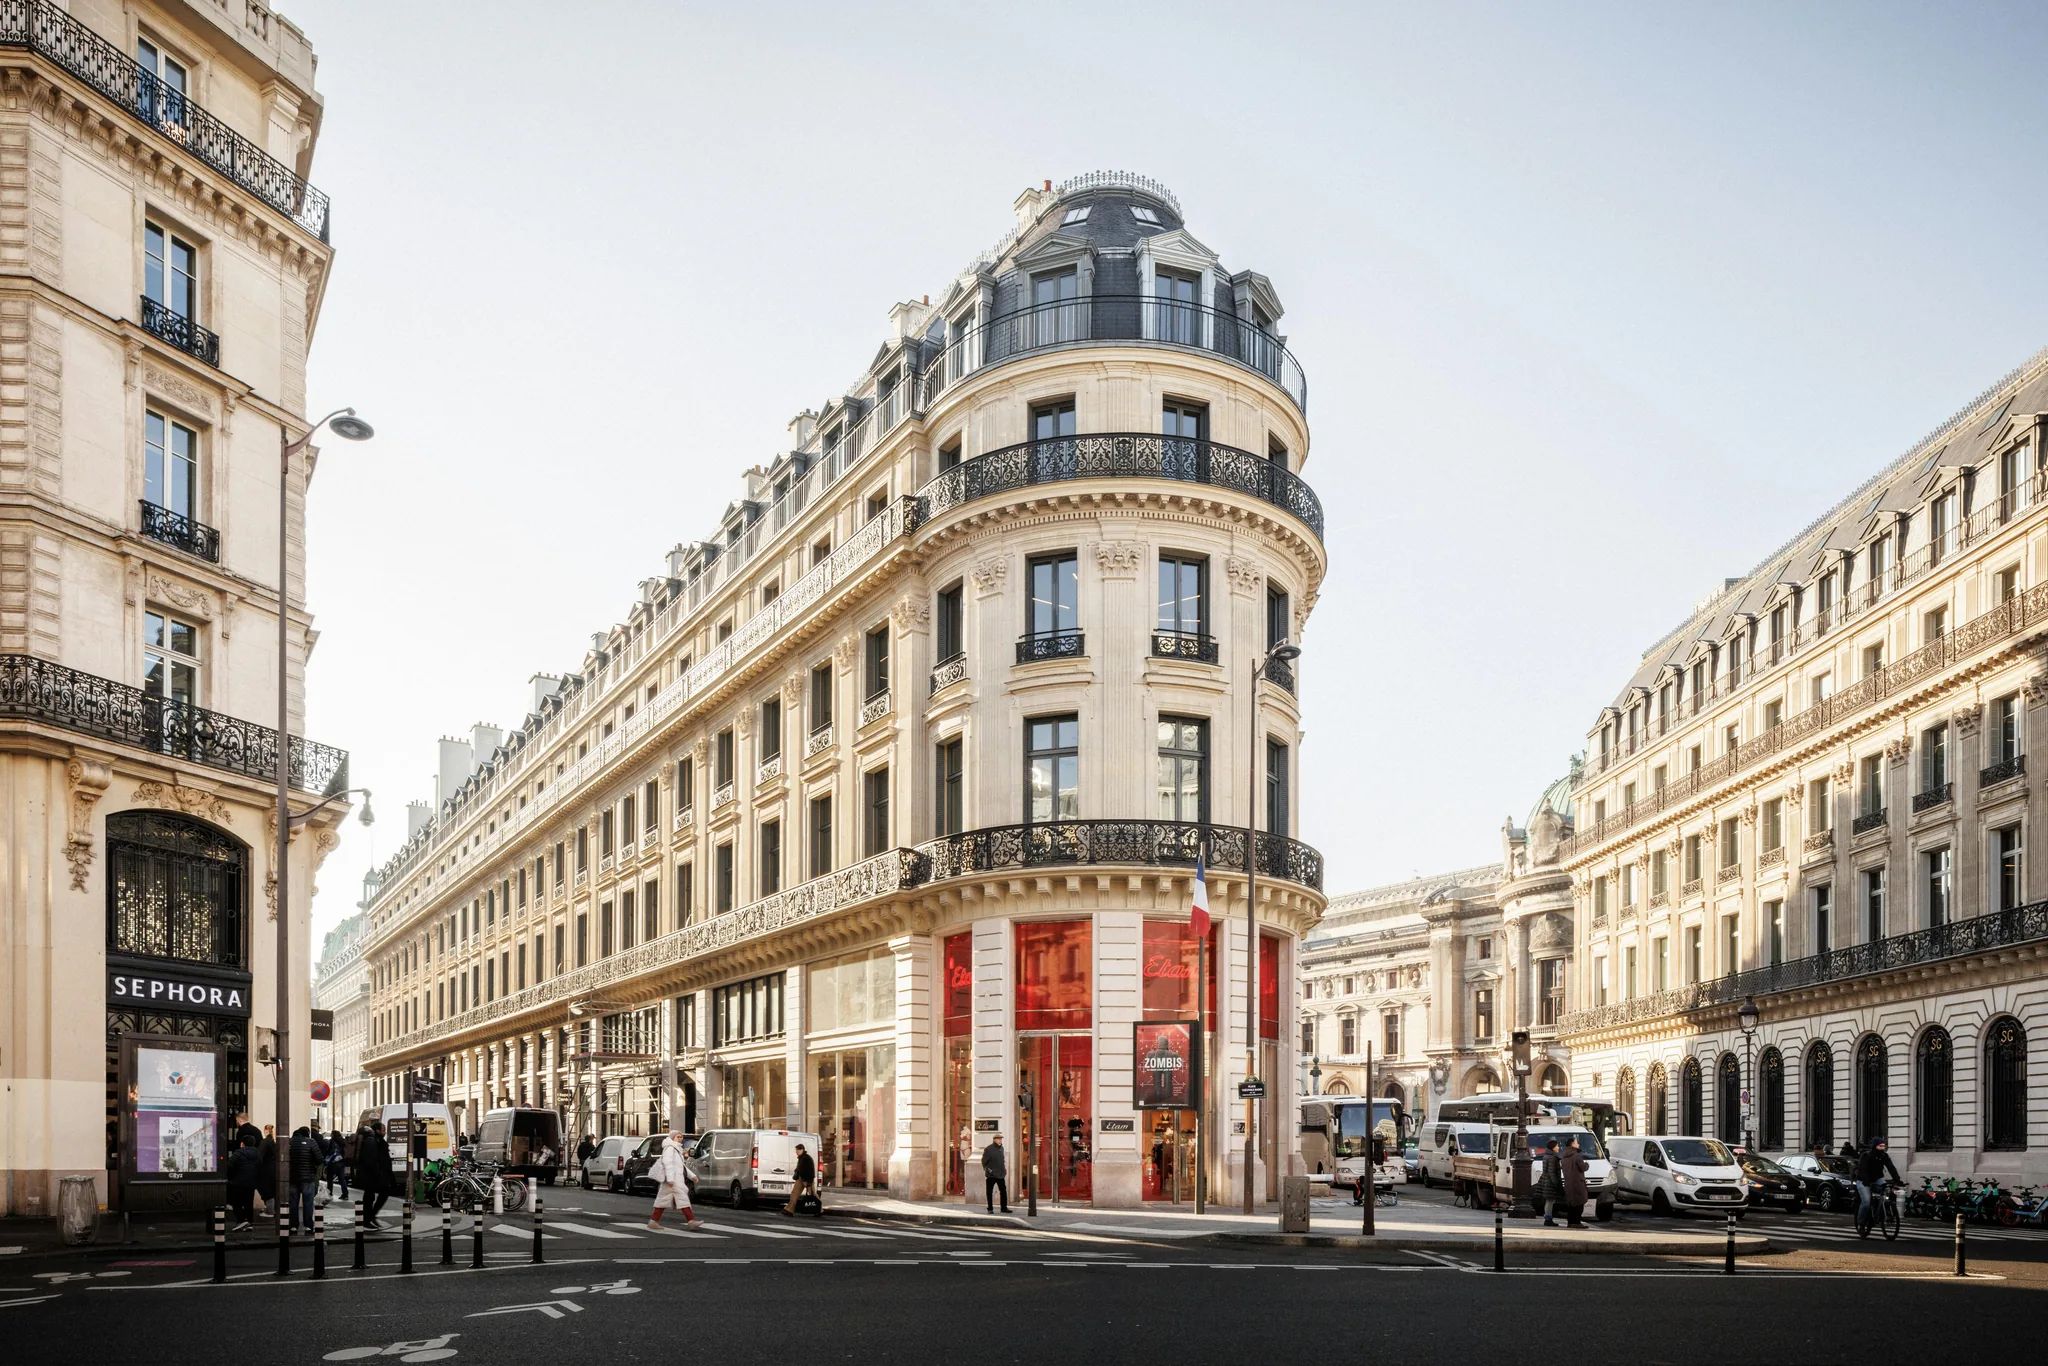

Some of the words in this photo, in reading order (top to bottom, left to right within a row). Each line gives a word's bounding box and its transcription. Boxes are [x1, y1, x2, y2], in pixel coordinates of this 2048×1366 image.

[114, 976, 242, 1008] SEPHORA
[2000, 1029, 2014, 1043] SG
[1930, 1037, 1943, 1051] SG
[1868, 1045, 1879, 1057] SG
[1144, 1057, 1183, 1069] ZOMBIS
[1769, 1056, 1778, 1068] SG
[1816, 1051, 1827, 1064] SG
[1106, 1121, 1129, 1130] Etam
